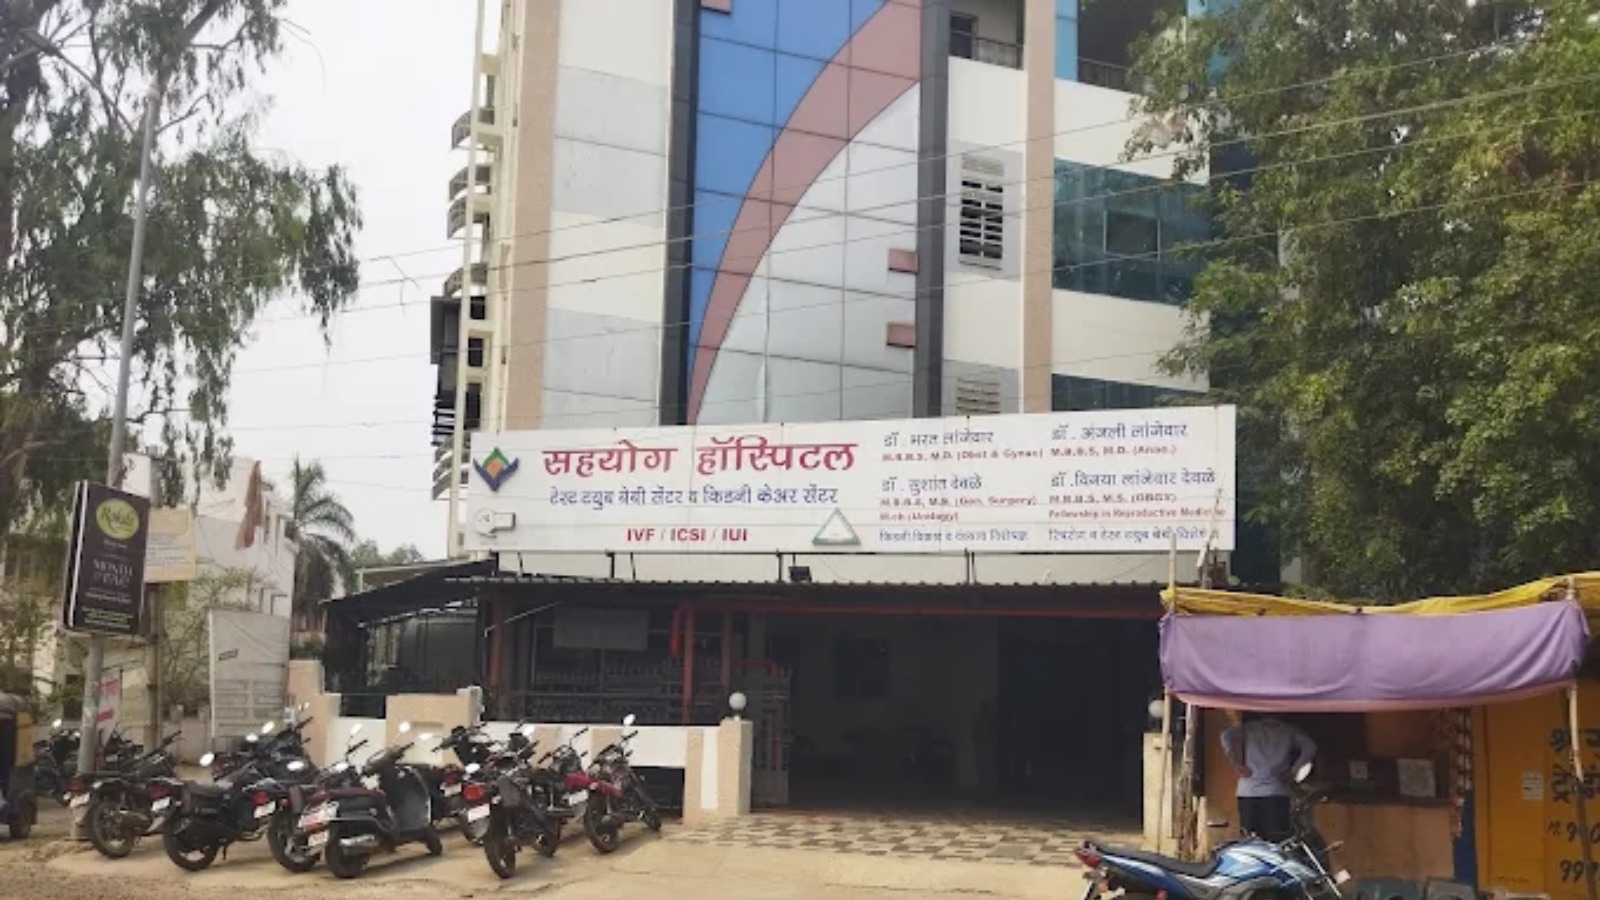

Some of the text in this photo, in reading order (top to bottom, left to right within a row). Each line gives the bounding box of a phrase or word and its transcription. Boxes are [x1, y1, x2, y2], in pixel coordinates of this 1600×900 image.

[541, 434, 859, 477] सहयोग हॉस्पिटल
[1112, 507, 1177, 519] Reproductive
[626, 527, 656, 542] IVF
[670, 527, 707, 542] ICSI
[722, 527, 748, 542] IUI
